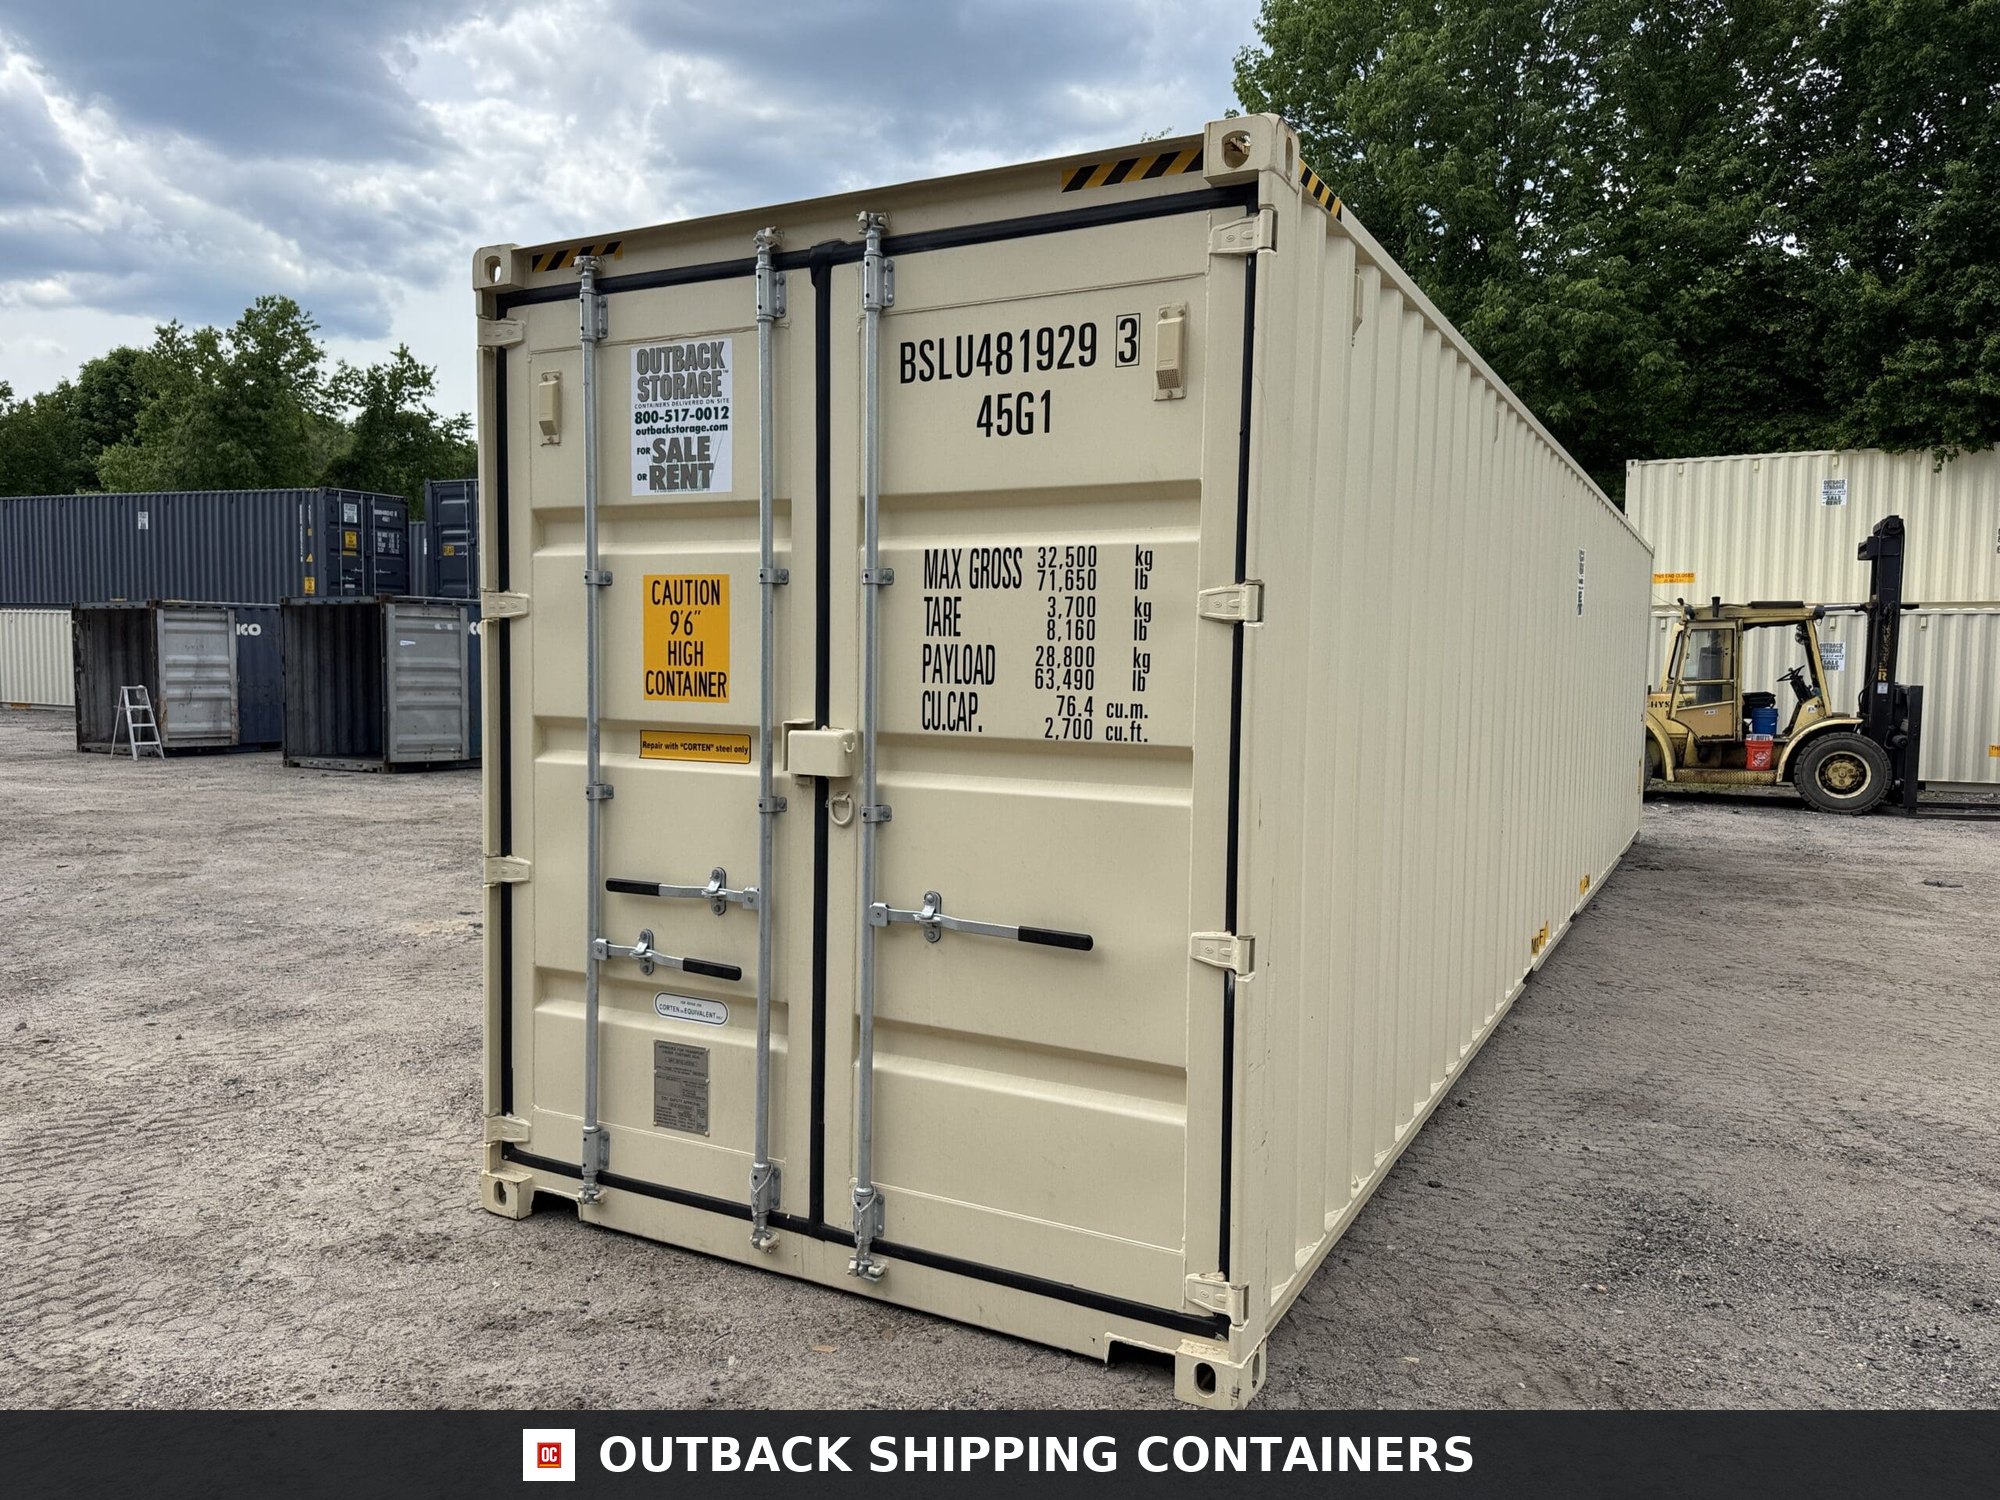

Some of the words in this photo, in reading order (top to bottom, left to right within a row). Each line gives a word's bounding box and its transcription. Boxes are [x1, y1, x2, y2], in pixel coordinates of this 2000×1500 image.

[637, 341, 725, 375] OUTBACK
[900, 322, 1097, 384] BSLU481929
[1118, 317, 1138, 364] 3
[637, 370, 722, 402] STORAGE
[634, 406, 729, 425] 800-517-0012
[976, 389, 1052, 438] 45G1
[636, 424, 728, 436] outbackstorage.com
[637, 447, 651, 455] FOR
[652, 436, 710, 464] SALE
[637, 473, 647, 481] OR
[649, 463, 714, 490] RENT
[923, 548, 962, 590] MAX
[969, 547, 1022, 589] GROSS
[1037, 545, 1097, 570] 32,500
[1135, 544, 1153, 572] kg
[1037, 568, 1097, 592] 71,650
[1134, 568, 1148, 590] lb
[652, 579, 720, 605] CAUTION
[923, 596, 962, 637] TARE
[1047, 596, 1096, 620] 3,700
[1134, 595, 1152, 623] kg
[1047, 618, 1095, 642] 8,160
[1133, 619, 1147, 641] lb
[668, 640, 703, 667] HIGH
[922, 643, 996, 685] PAYLOAD
[1035, 645, 1095, 669] 28,800
[1133, 646, 1151, 674] kg
[645, 670, 727, 698] CONTAINER
[1034, 668, 1094, 692] 63,490
[1132, 670, 1146, 692] lb
[921, 690, 983, 733] CU.CAP.
[1056, 695, 1094, 718] 76.4
[1106, 701, 1149, 719] cu.m.
[1044, 717, 1093, 741] 2,700
[1105, 720, 1149, 743] cu.ft.
[642, 741, 663, 750] Repair
[665, 742, 678, 750] with
[734, 745, 748, 755] only
[659, 1003, 680, 1013] CORTEN
[684, 1007, 716, 1019] EQUIVALENT
